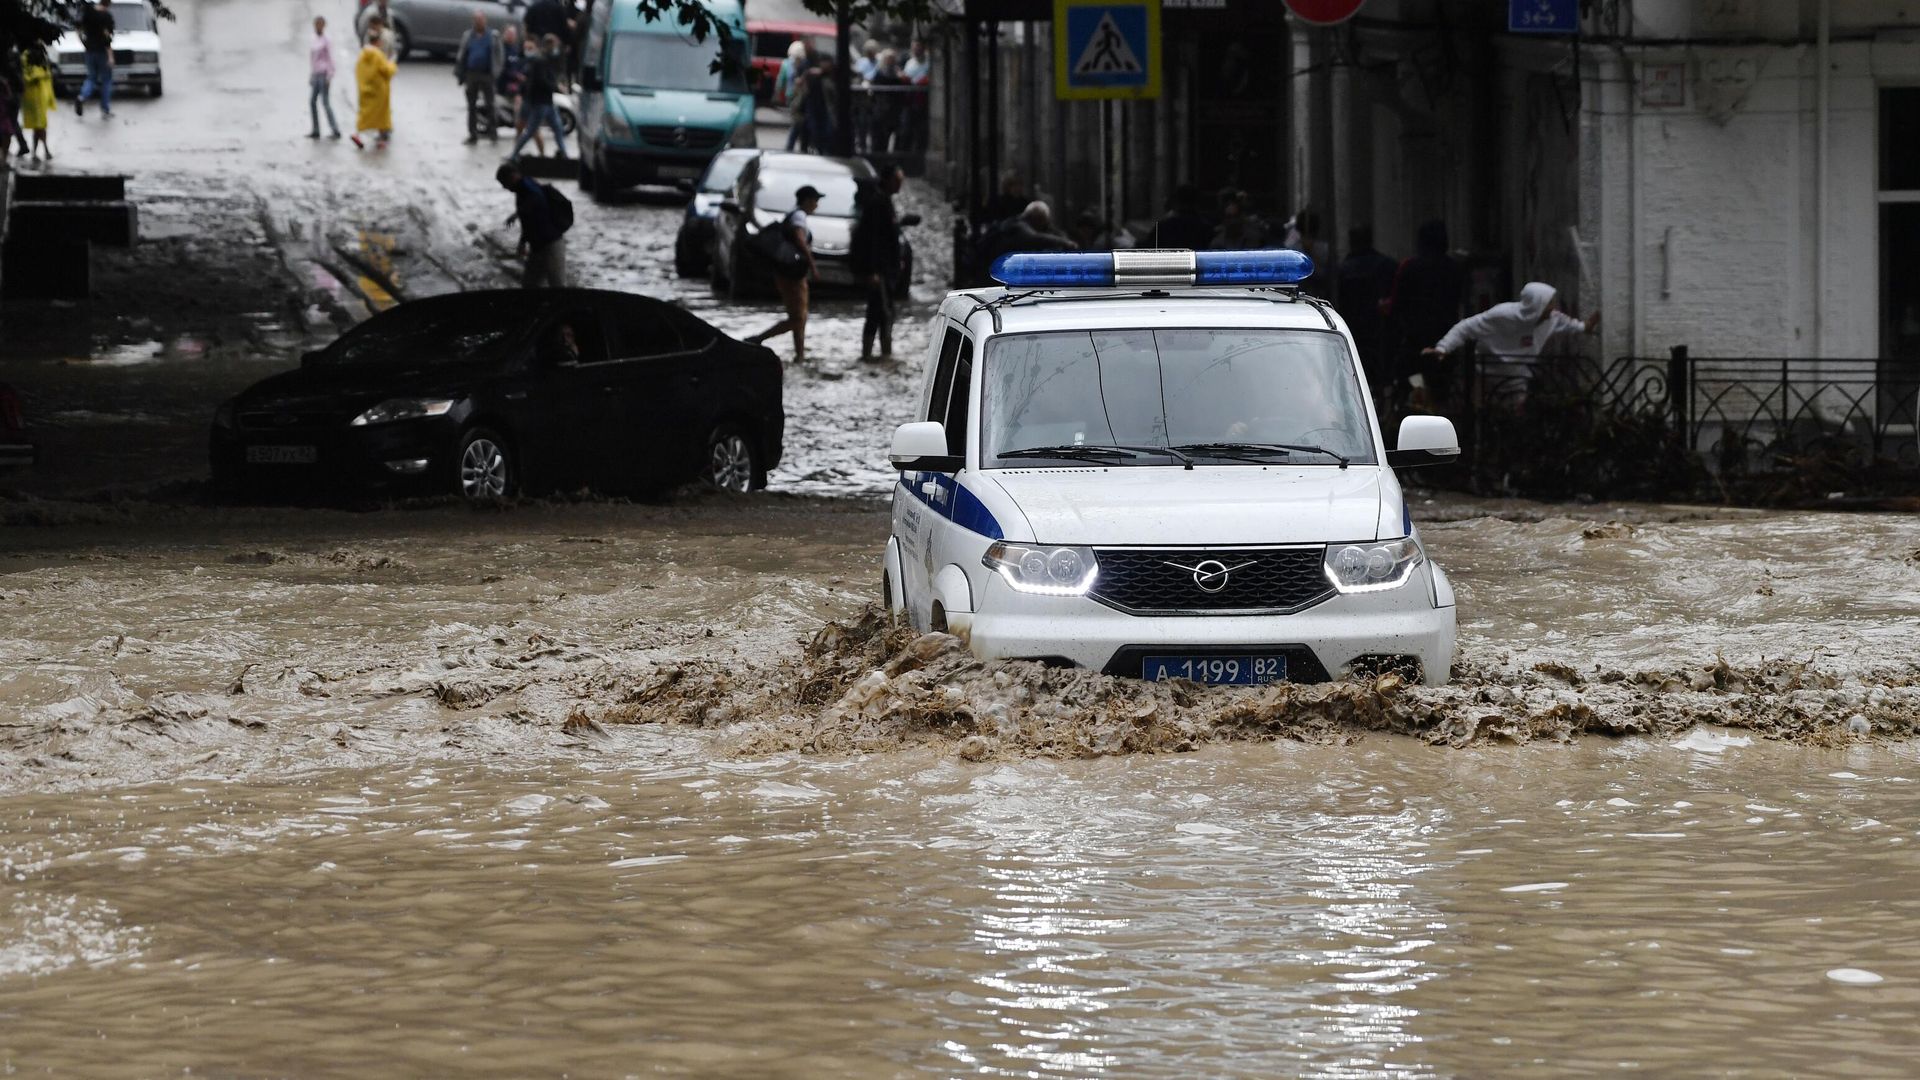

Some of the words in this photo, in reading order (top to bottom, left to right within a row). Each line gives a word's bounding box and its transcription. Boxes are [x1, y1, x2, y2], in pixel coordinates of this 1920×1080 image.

[1181, 660, 1239, 682] 1199
[1255, 658, 1278, 675] 82
[1257, 675, 1275, 683] RUS
